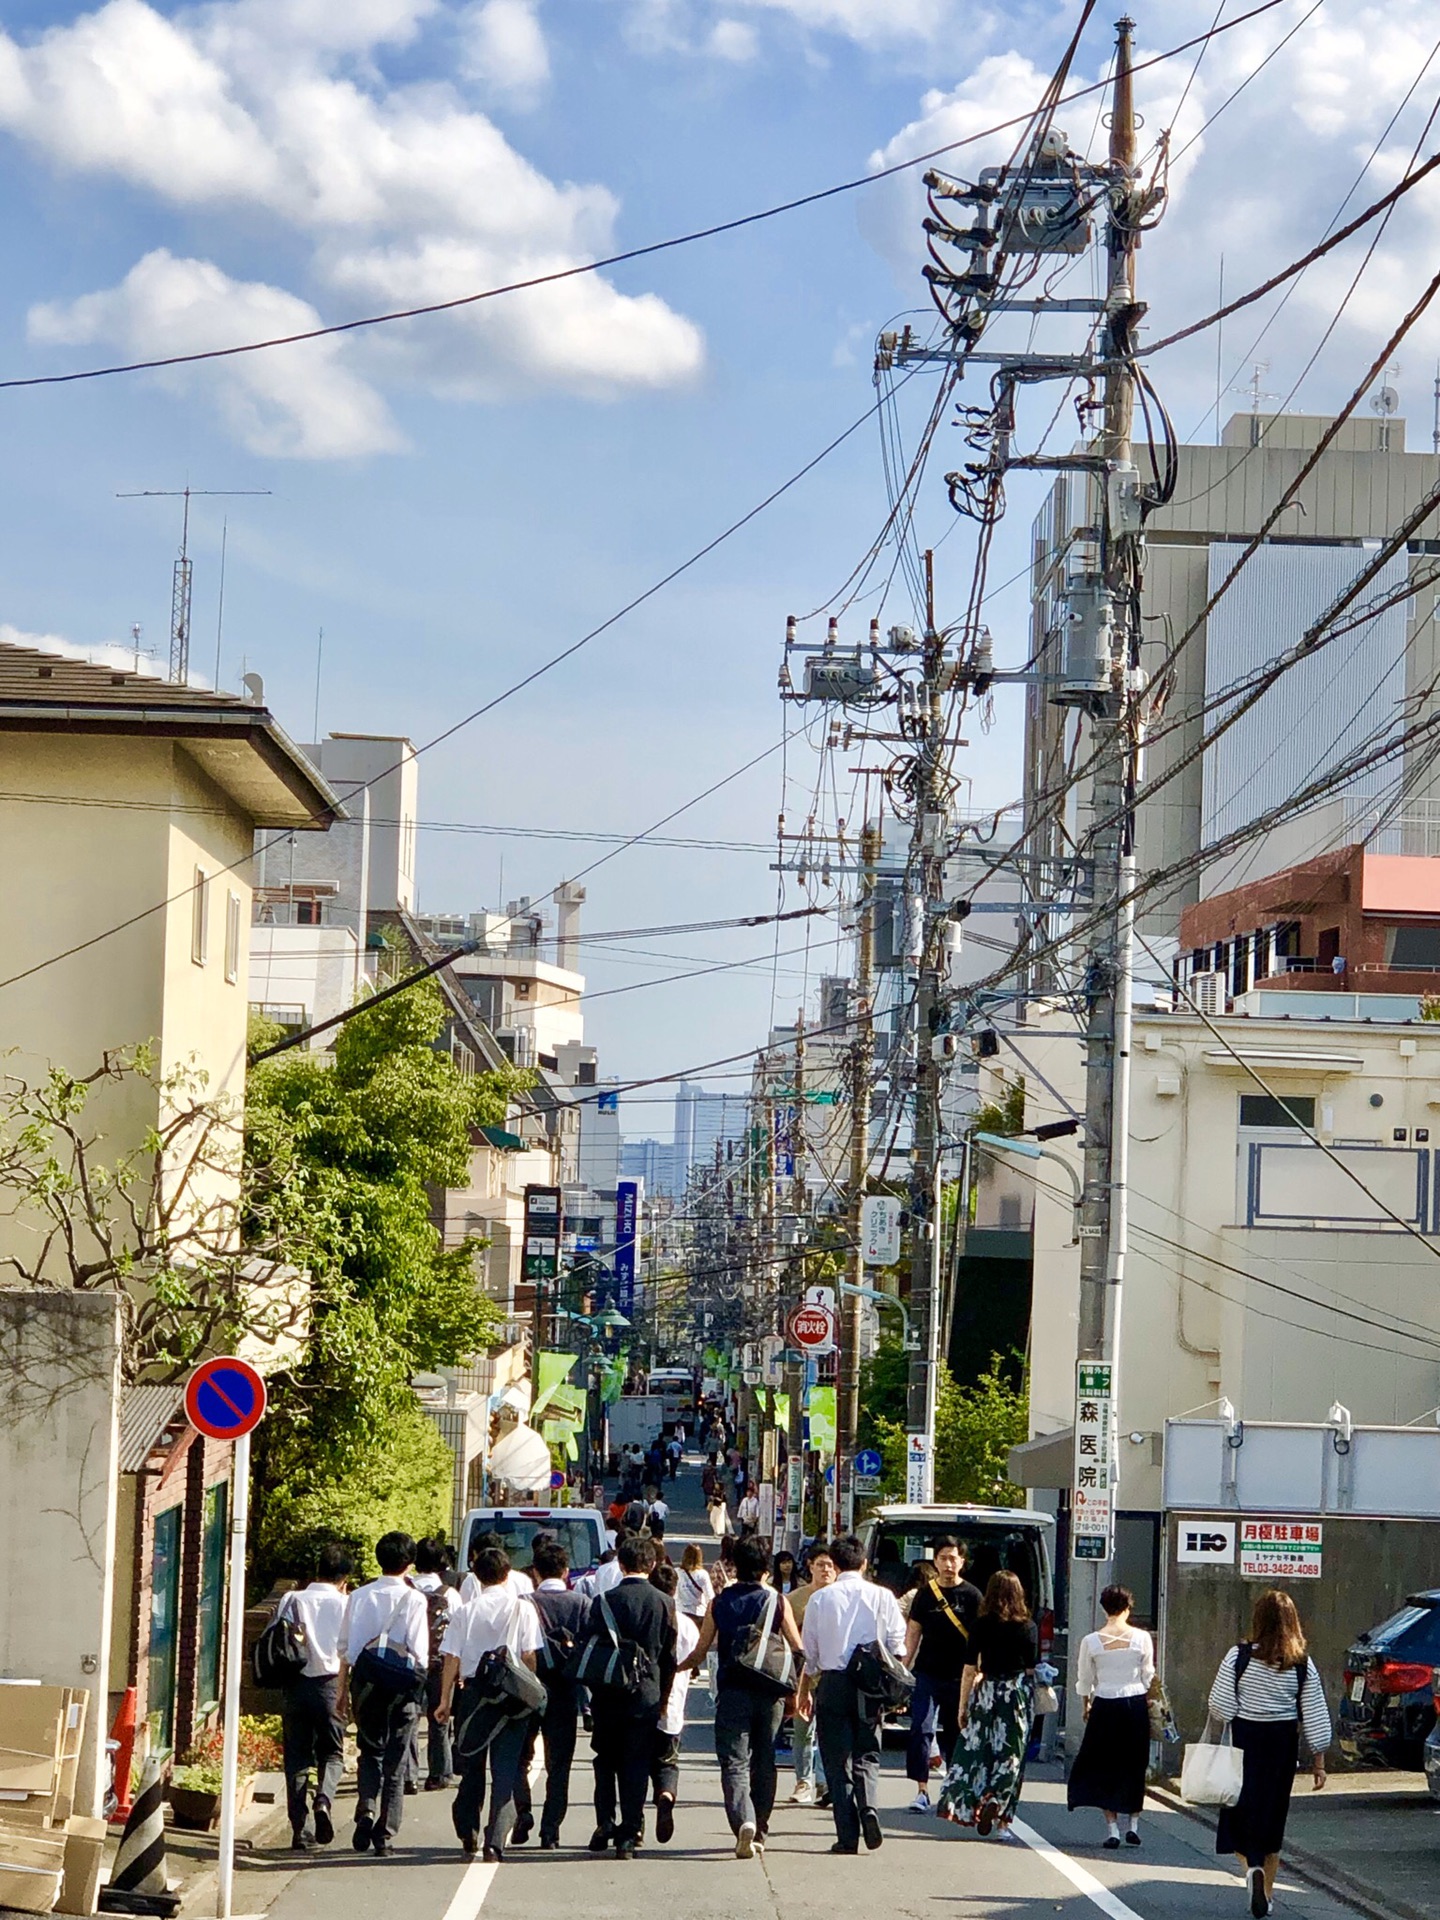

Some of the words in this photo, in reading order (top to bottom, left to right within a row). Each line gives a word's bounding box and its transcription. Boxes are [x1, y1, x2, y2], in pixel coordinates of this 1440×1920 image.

[797, 1320, 826, 1335] 消火栓
[1078, 1401, 1099, 1488] 森医院
[1244, 1523, 1319, 1541] 月極駐車場
